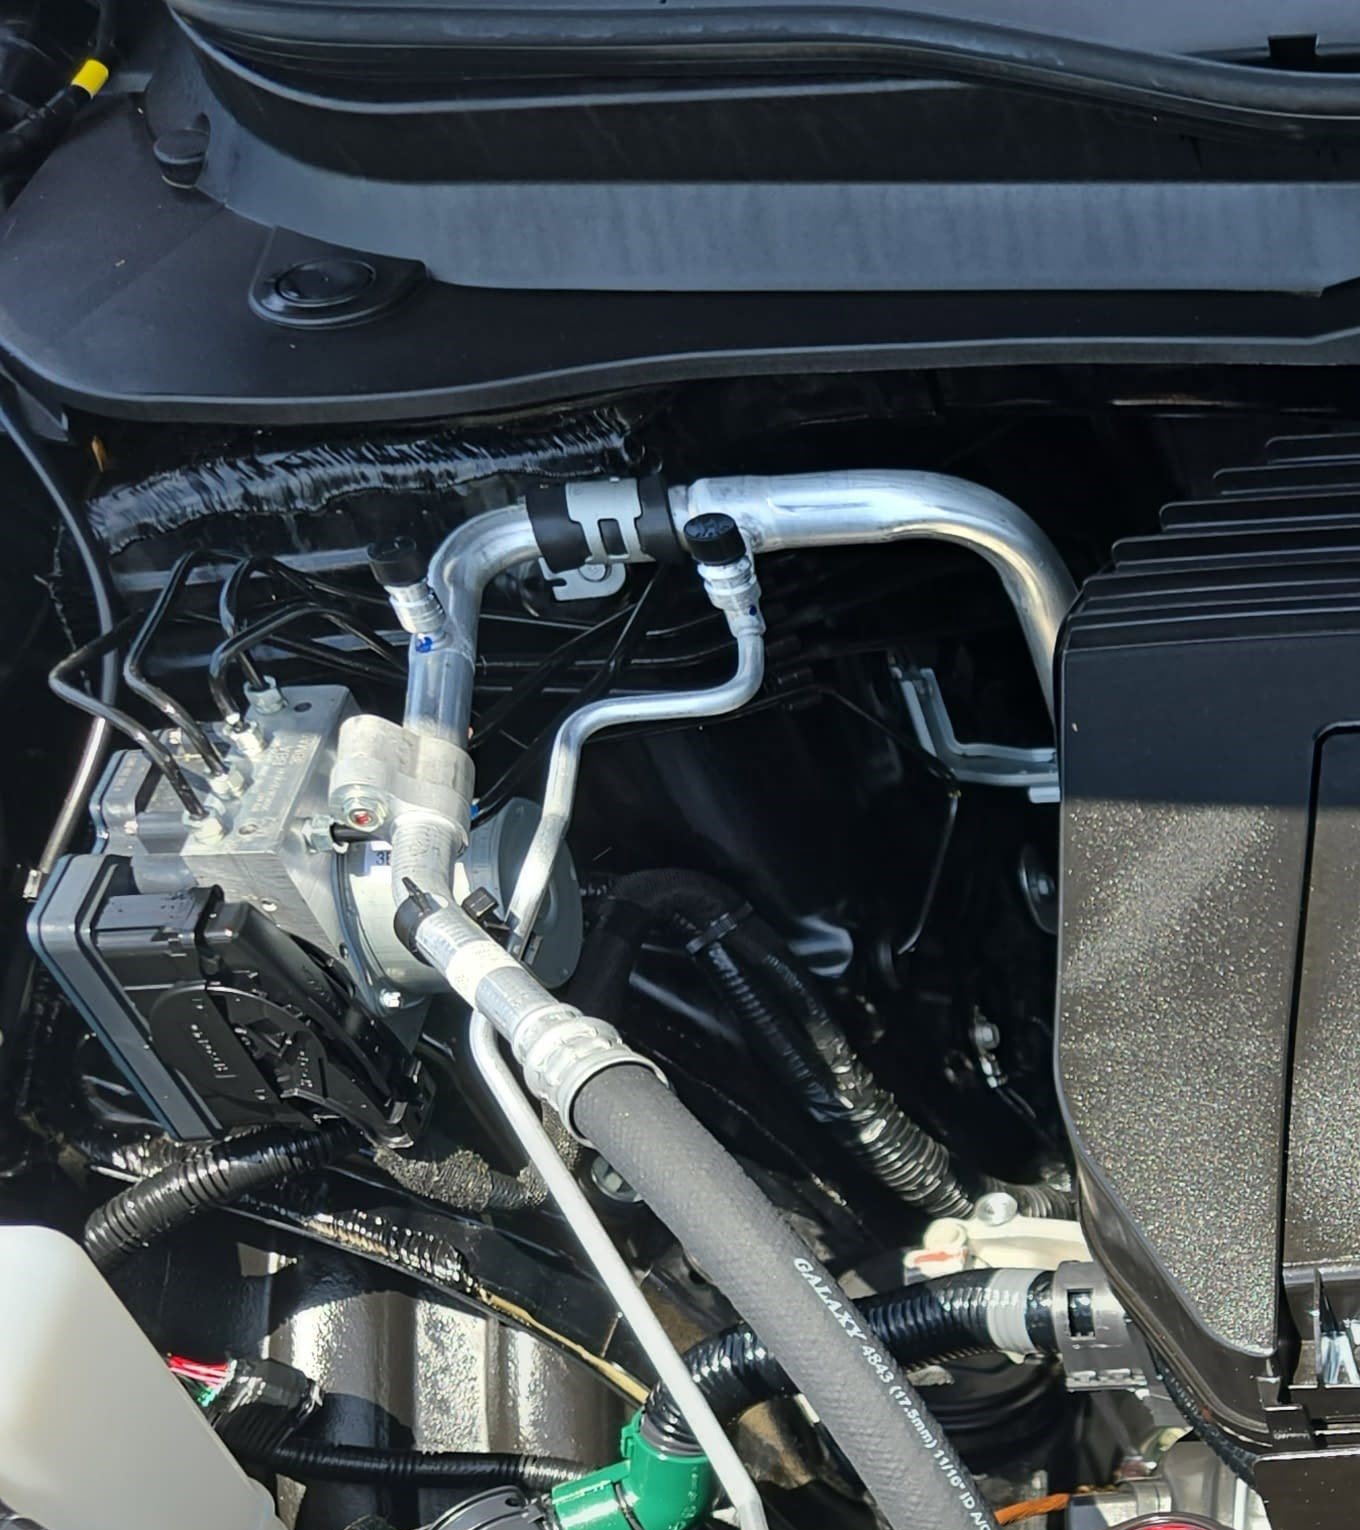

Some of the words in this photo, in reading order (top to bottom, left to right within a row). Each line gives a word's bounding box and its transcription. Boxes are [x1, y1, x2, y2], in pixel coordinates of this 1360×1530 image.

[793, 1256, 867, 1342] GALAXY
[861, 1343, 895, 1385] 4843
[888, 1383, 938, 1450] (17.5mm)
[958, 1489, 976, 1511] ID
